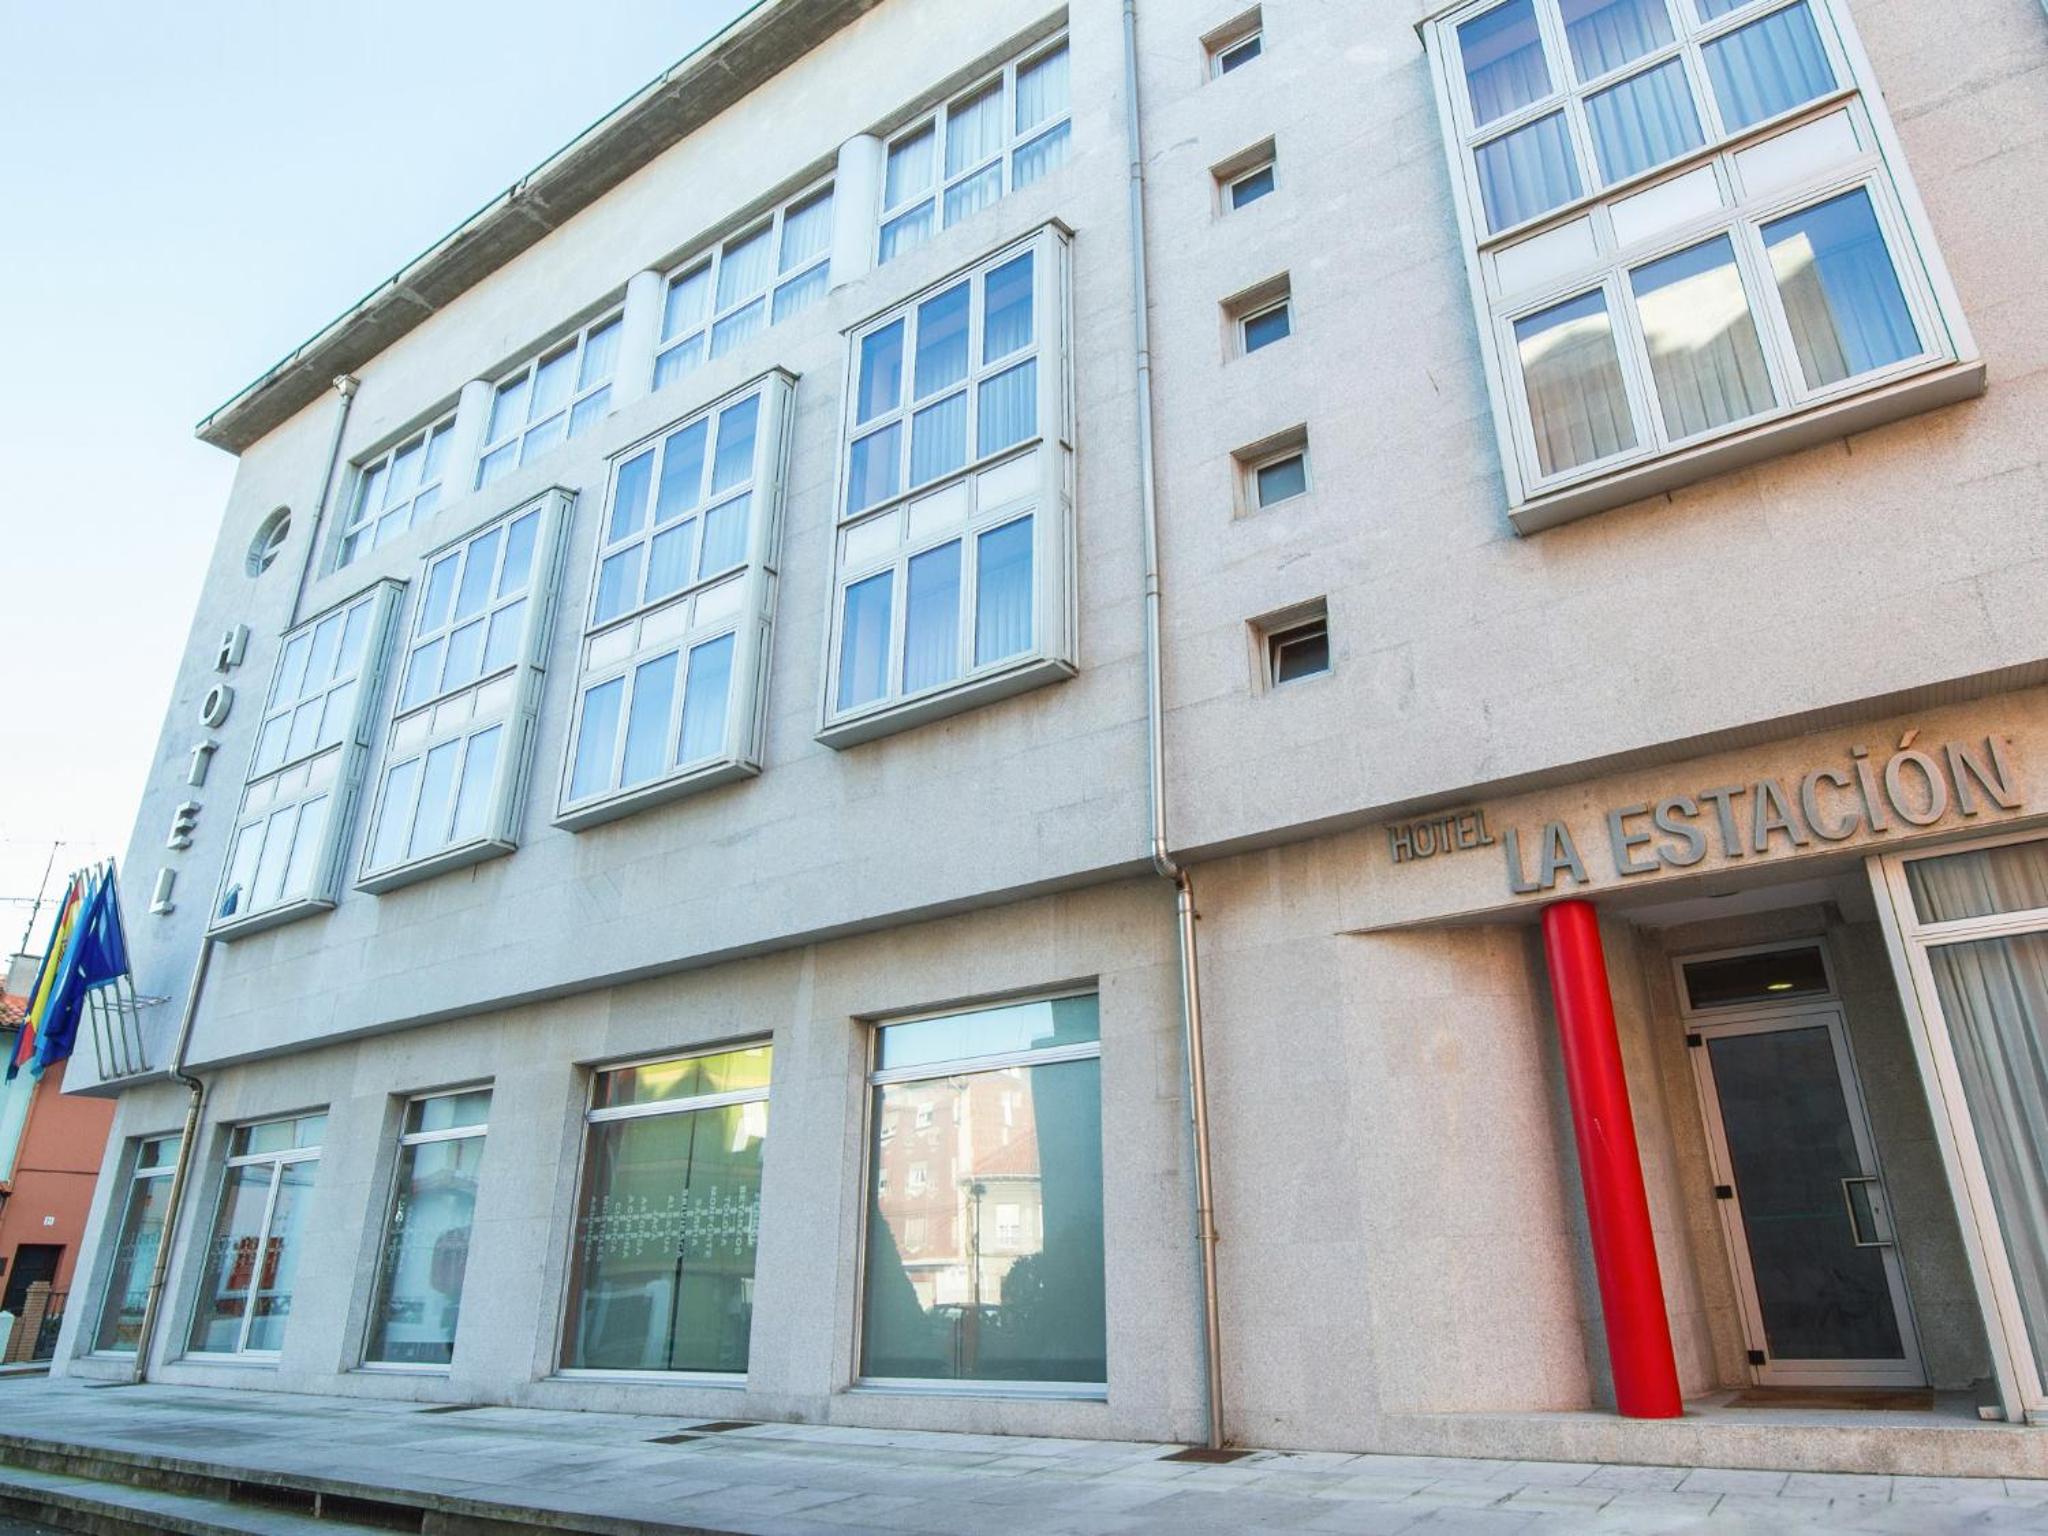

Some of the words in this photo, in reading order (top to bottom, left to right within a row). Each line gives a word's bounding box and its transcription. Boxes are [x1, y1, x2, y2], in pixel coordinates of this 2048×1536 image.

[150, 623, 250, 916] HOTEL
[1387, 810, 1494, 863] HOTEL
[1505, 821, 1589, 894] LA
[1608, 730, 2021, 877] ESTACIÓN
